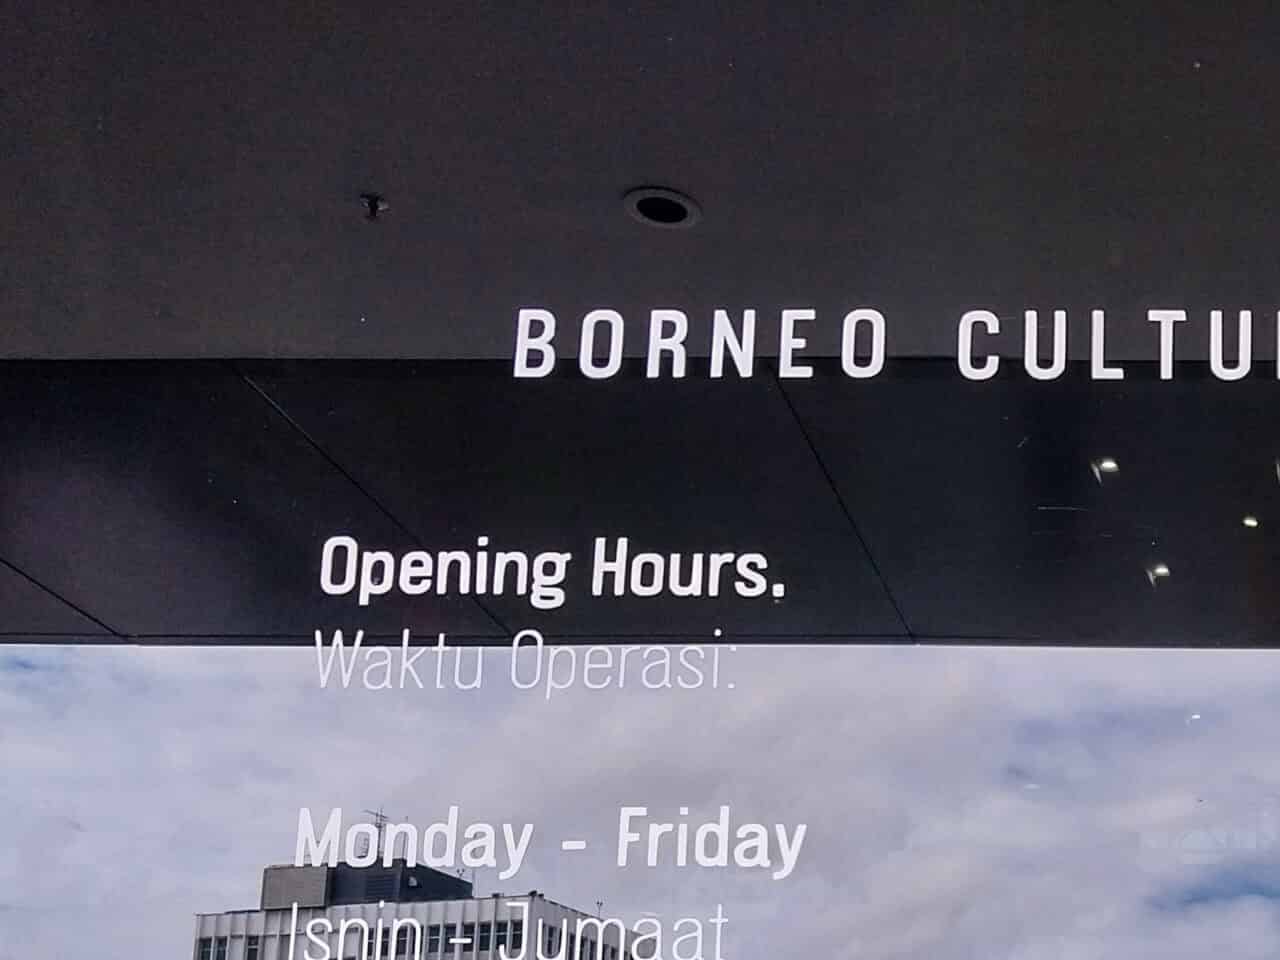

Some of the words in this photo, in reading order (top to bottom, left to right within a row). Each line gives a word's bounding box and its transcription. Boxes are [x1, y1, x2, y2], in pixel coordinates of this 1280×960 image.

[513, 308, 887, 381] BORNEO
[319, 536, 572, 609] Opening
[591, 537, 787, 599] Hours.
[314, 628, 484, 690] Waktu
[510, 628, 737, 700] Operasi:
[294, 806, 534, 880] Monday
[561, 840, 587, 850] -
[616, 805, 807, 880] Friday
[448, 936, 473, 945] -
